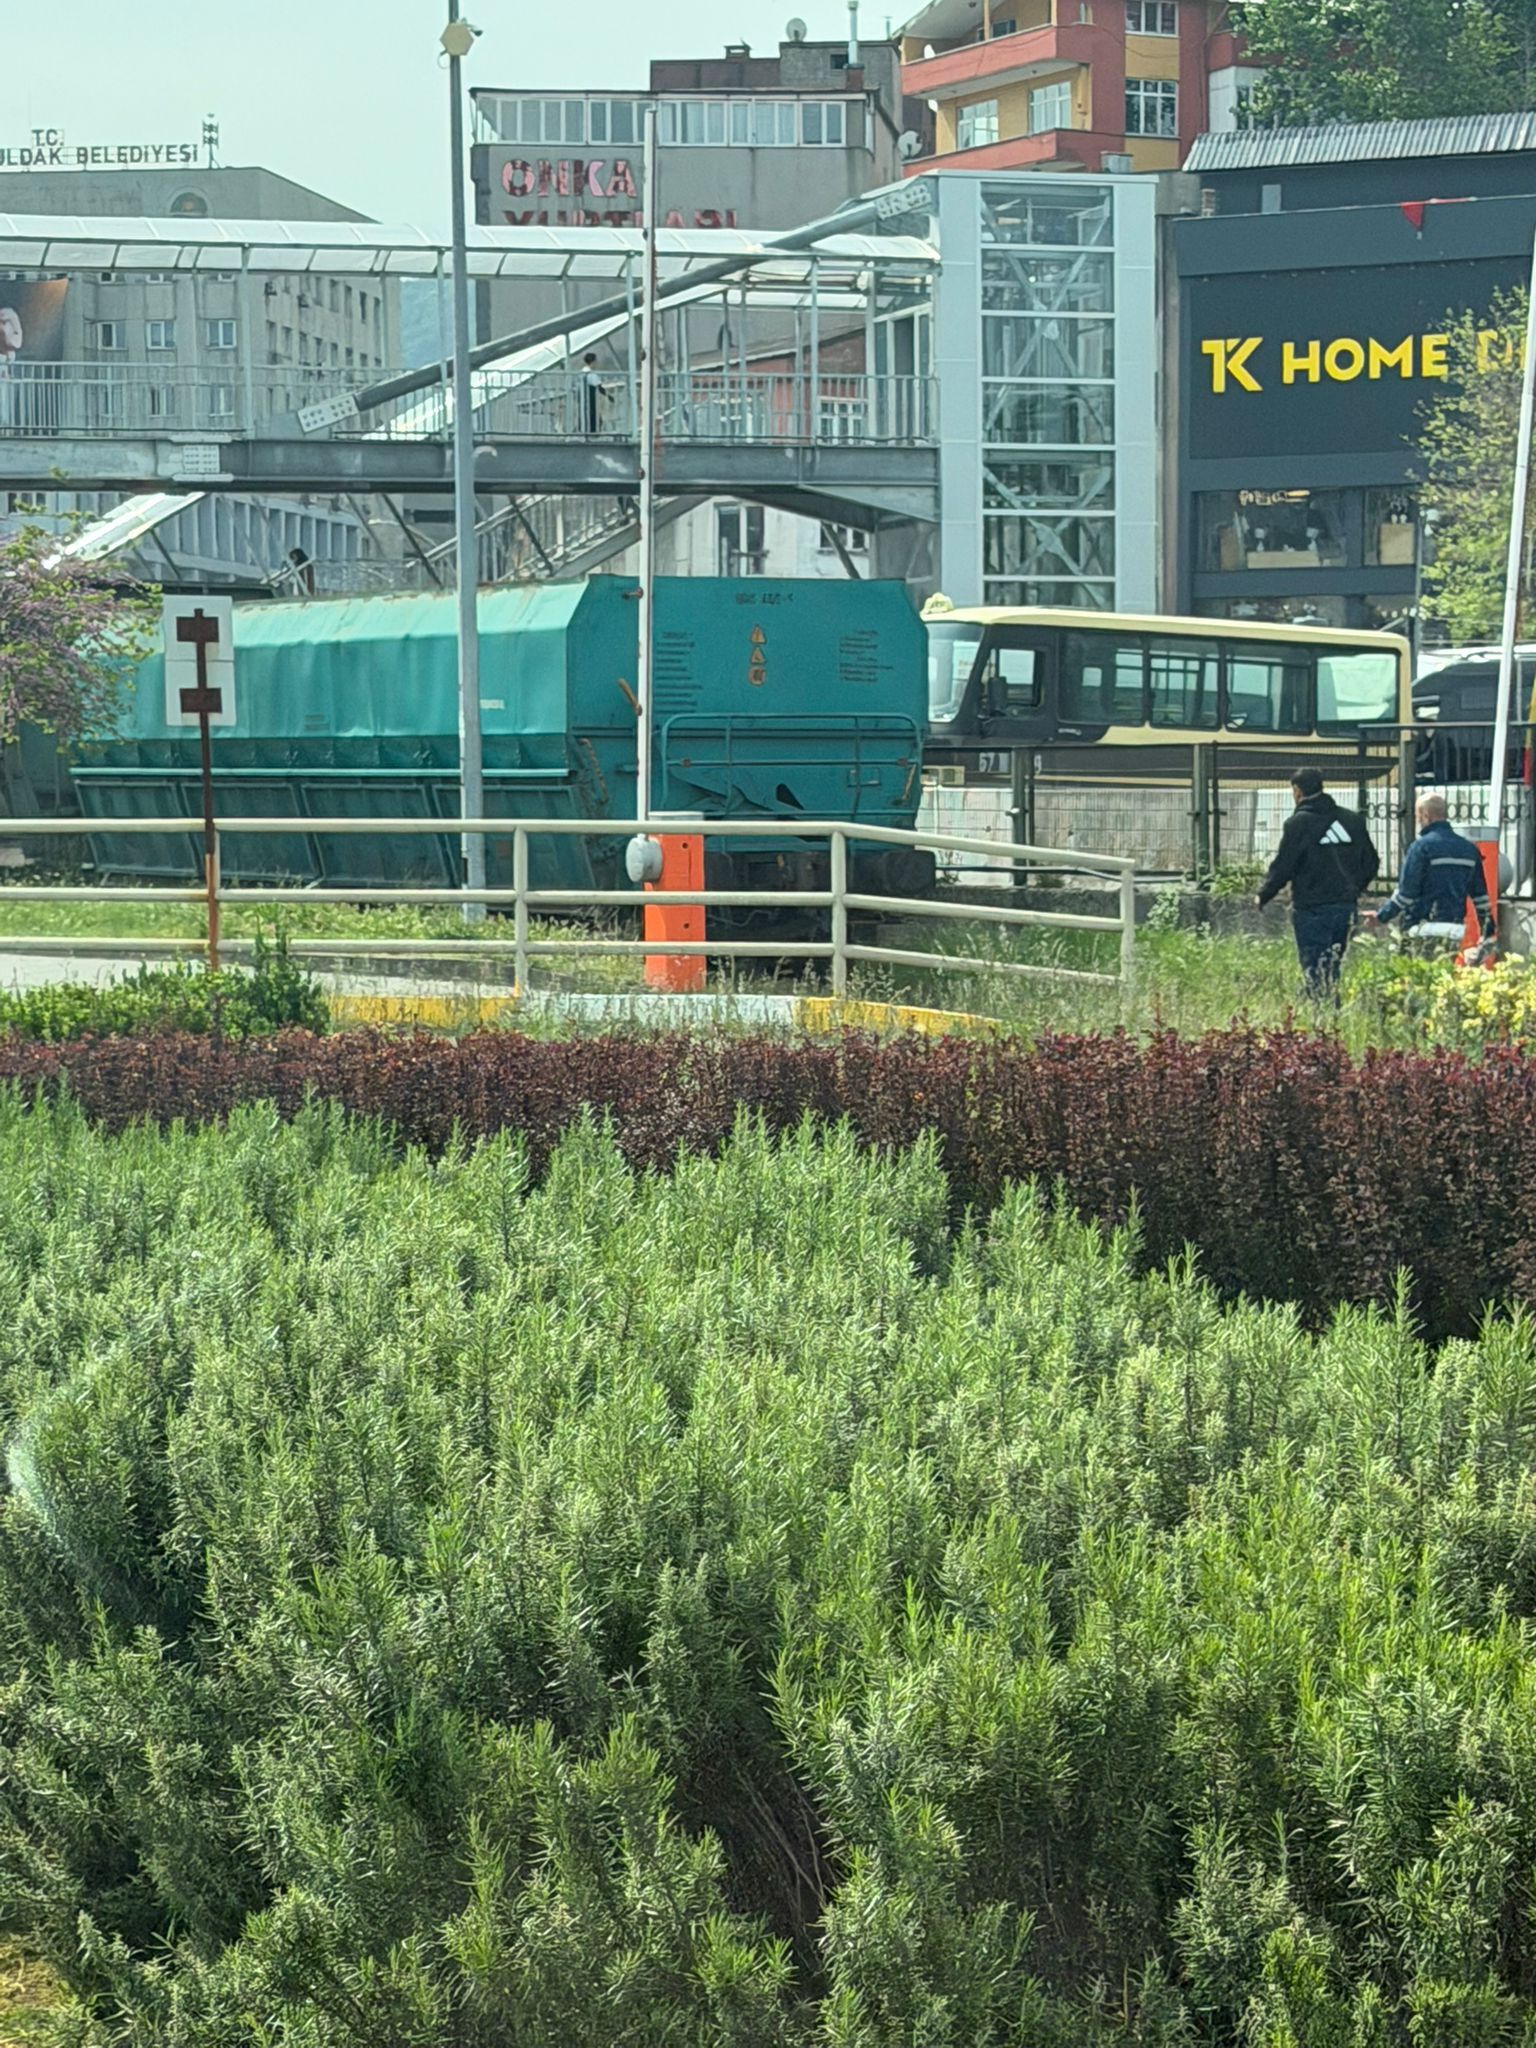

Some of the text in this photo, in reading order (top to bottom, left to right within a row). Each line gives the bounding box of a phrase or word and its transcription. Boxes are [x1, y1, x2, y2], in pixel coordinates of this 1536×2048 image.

[31, 129, 64, 147] T.C.
[502, 159, 638, 198] ONKA
[1202, 337, 1263, 393] TK
[1282, 334, 1449, 384] HOME
